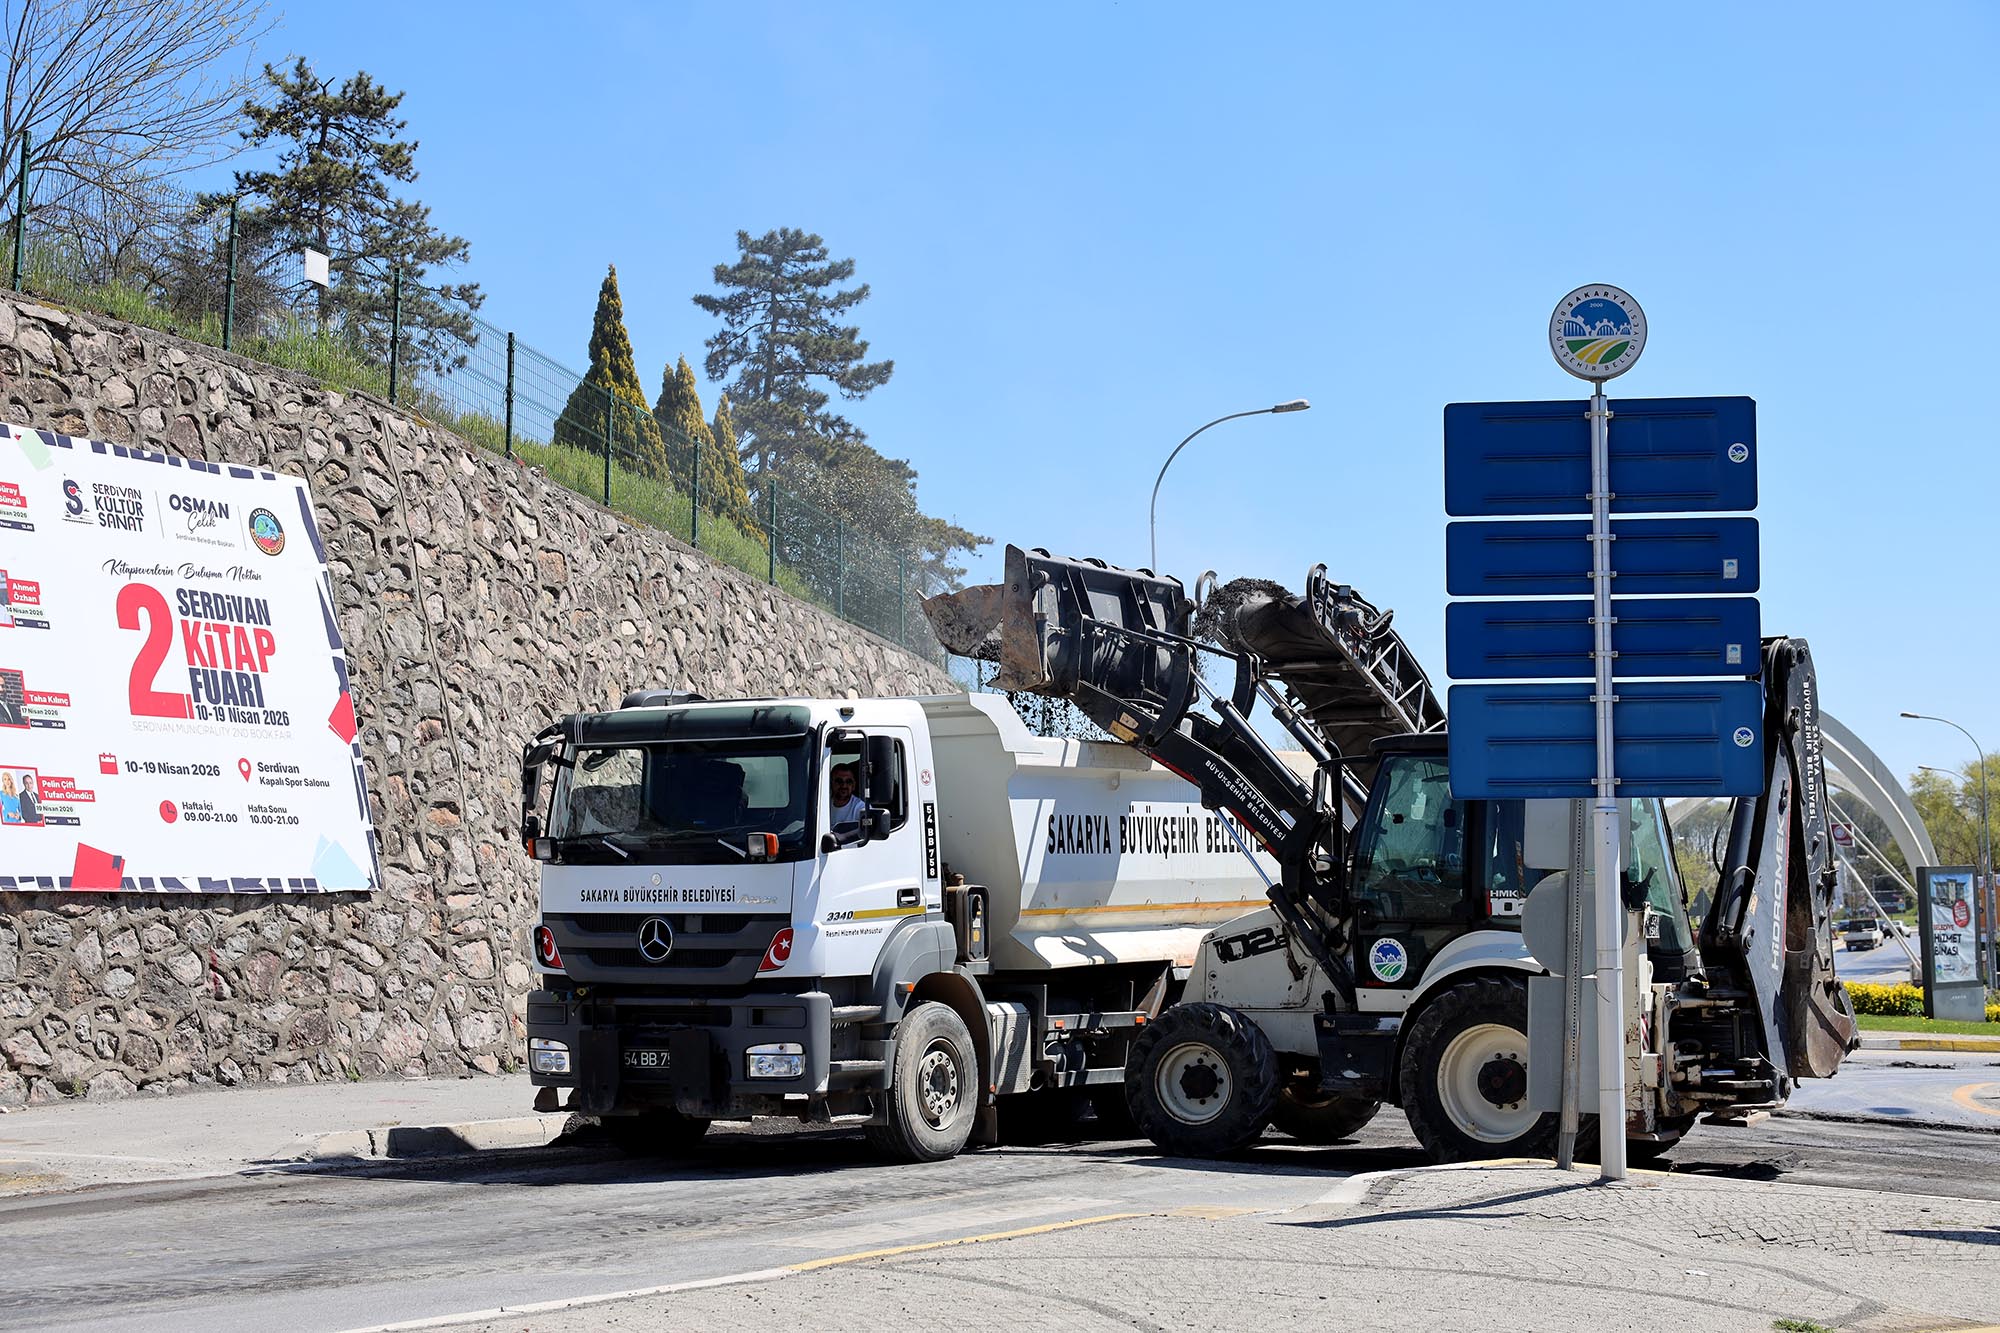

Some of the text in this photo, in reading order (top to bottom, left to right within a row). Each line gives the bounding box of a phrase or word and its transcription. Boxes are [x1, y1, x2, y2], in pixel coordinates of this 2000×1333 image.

[1567, 291, 1626, 308] SAKARYA
[94, 495, 145, 517] KÜLTÜR
[168, 493, 230, 519] OSMAN
[98, 512, 143, 532] SANAT
[13, 582, 37, 592] Ahmet
[13, 591, 37, 602] Özhan
[188, 667, 265, 708] FUARI
[29, 694, 48, 703] Taha
[195, 704, 290, 726] 10-19 Nisan 2026
[1811, 725, 1820, 776] SAKARYA
[124, 760, 220, 776] 10-19 Nisan 2026
[257, 762, 300, 774] Serdivan
[42, 779, 74, 790] Pelin Çift
[259, 776, 330, 788] Kapalı Spor Salonu
[44, 790, 93, 800] Tufan Gündüz
[1234, 777, 1265, 810] SAKARYA
[182, 801, 203, 811] Hafta
[1205, 760, 1287, 841] BÜYÜKŞEHİR BELEDİYESİ
[247, 804, 287, 813] Hafta Sonu
[184, 811, 238, 823] 09.00-21.00
[250, 814, 299, 825] 10.00-21.00
[1048, 814, 1111, 855] SAKARYA
[1120, 805, 1199, 859] BÜYÜKŞEHİR
[580, 889, 619, 902] SAKARYA
[623, 886, 678, 904] BÜYÜKŞEHİR
[682, 885, 736, 902] BELEDİYESİ
[1490, 890, 1519, 898] HMK
[826, 910, 853, 922] 3340
[624, 1052, 637, 1065] 54
[641, 1052, 657, 1066] BB
